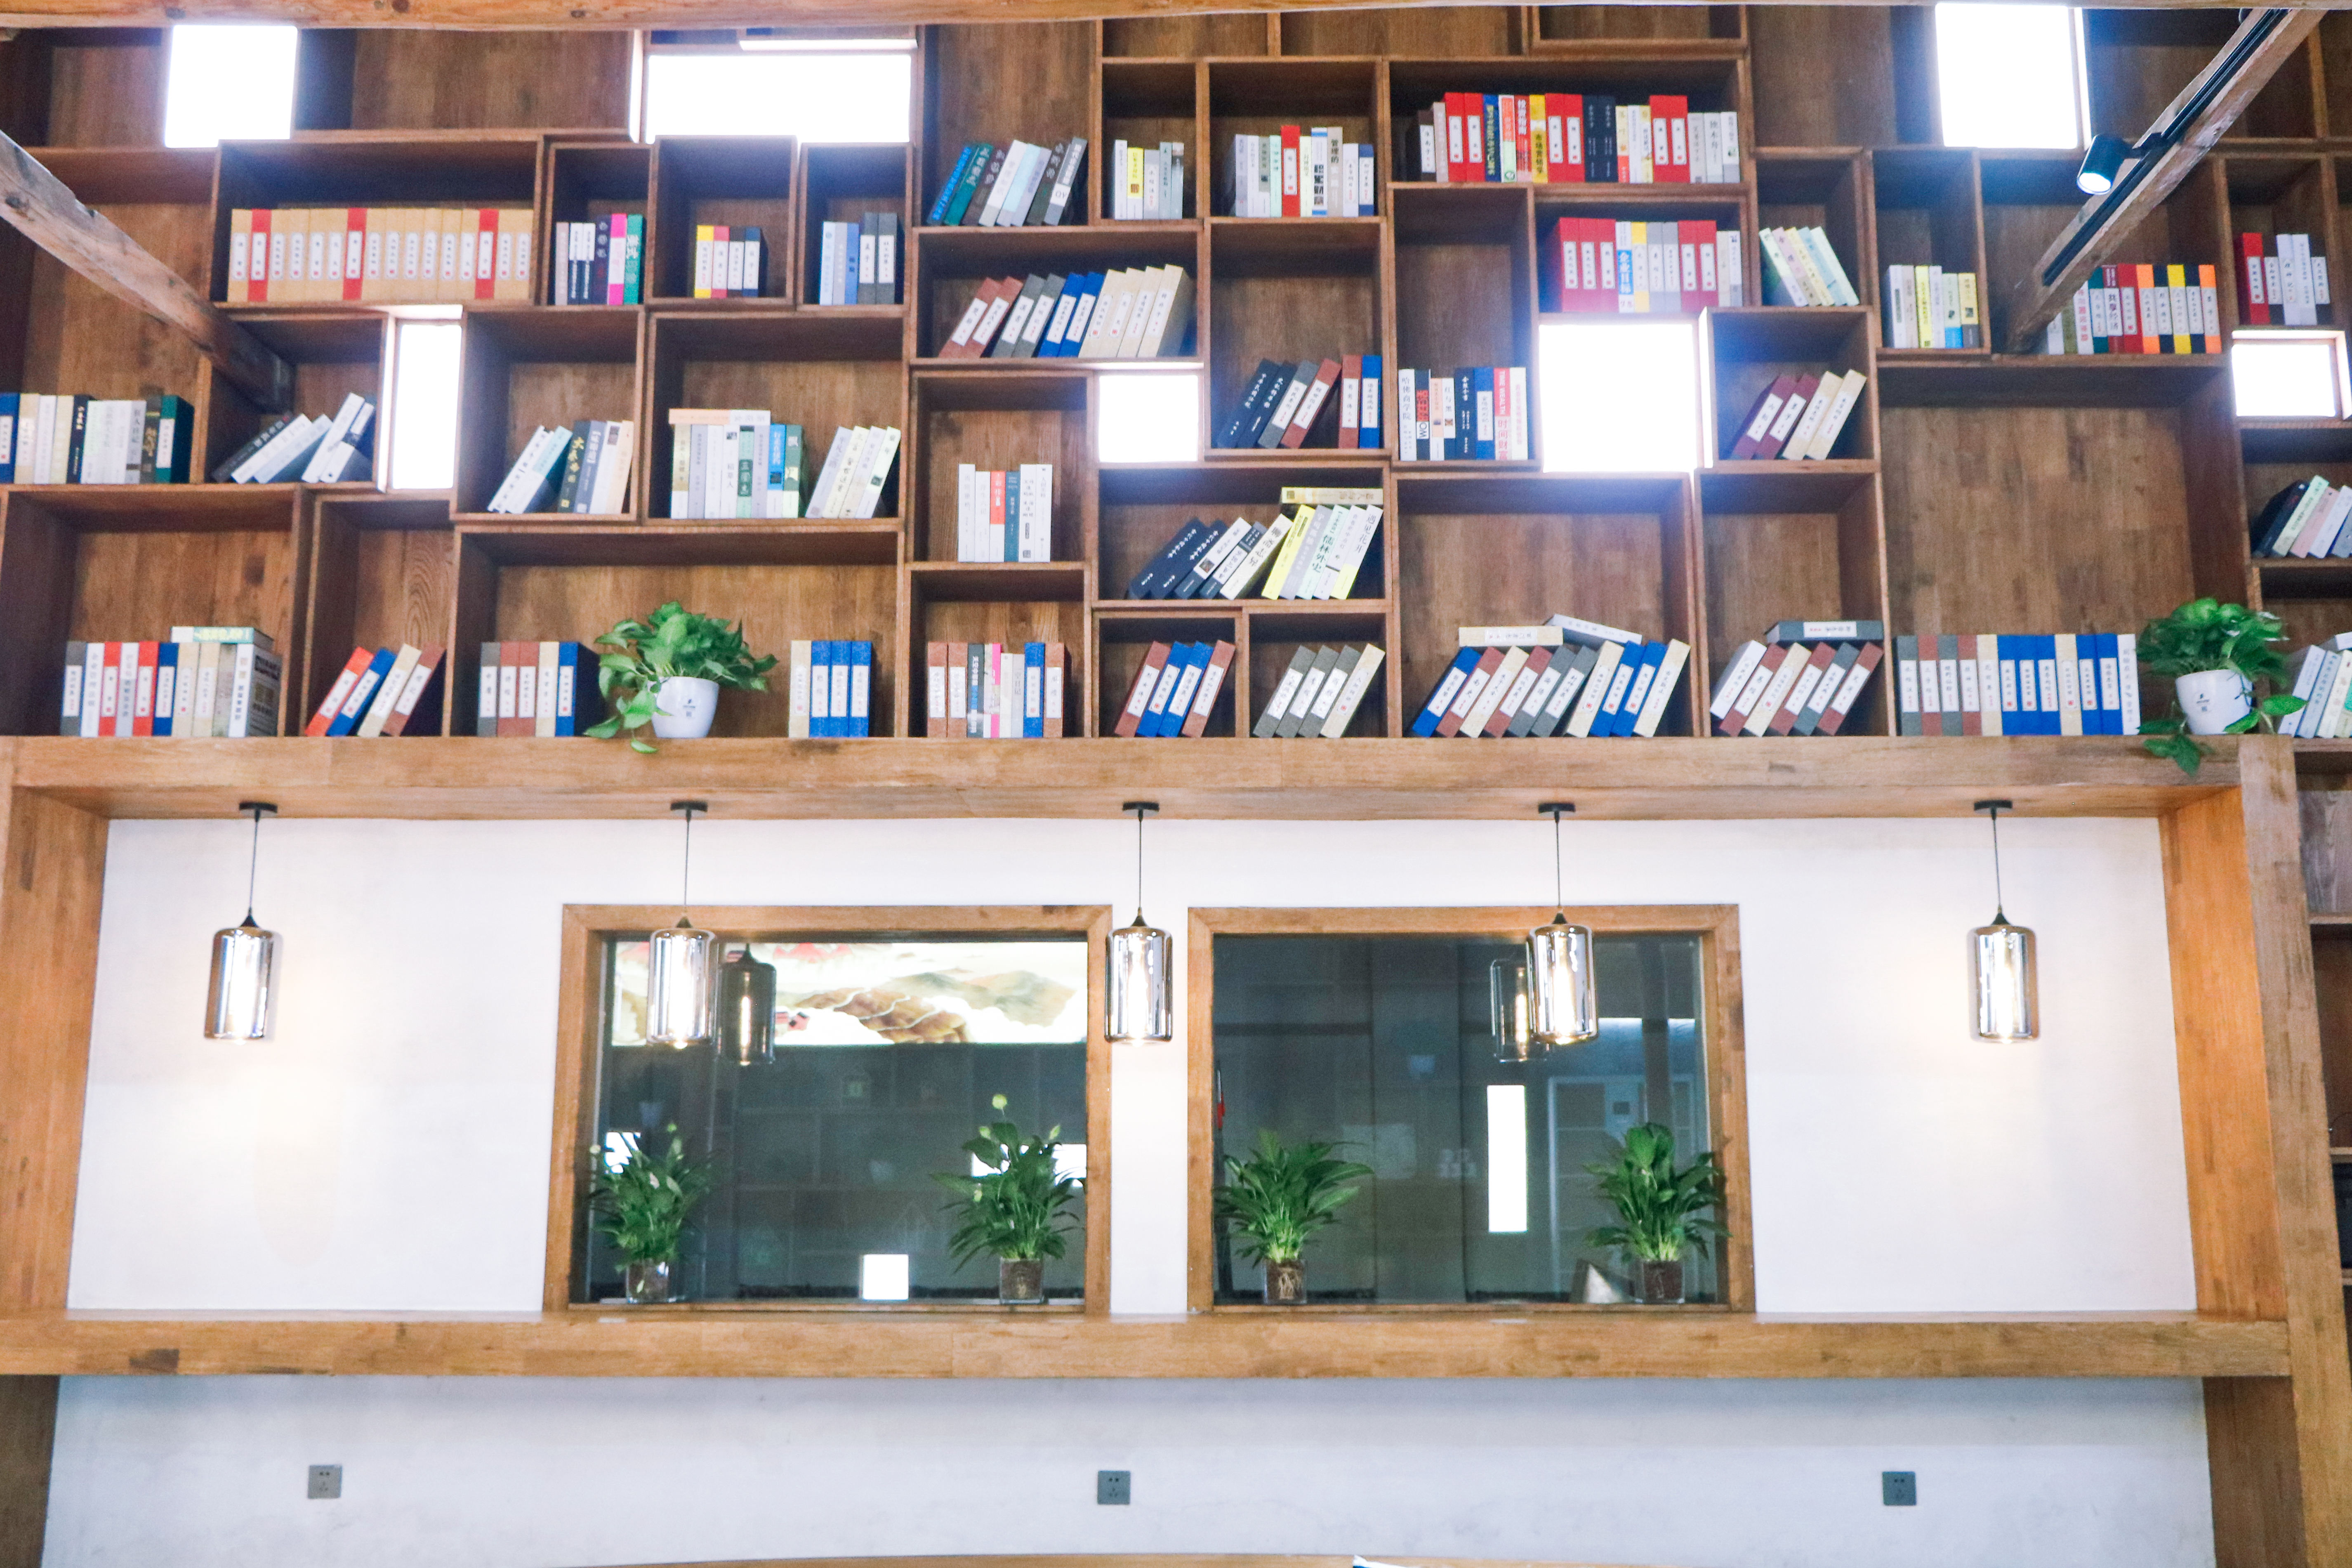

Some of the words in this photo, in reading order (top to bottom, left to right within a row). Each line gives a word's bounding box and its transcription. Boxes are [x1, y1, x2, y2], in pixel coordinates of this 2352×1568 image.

[1402, 376, 1412, 420] 哈佛商学院
[1310, 534, 1335, 574] 儒林外史
[1354, 513, 1378, 555] 遇见花开
